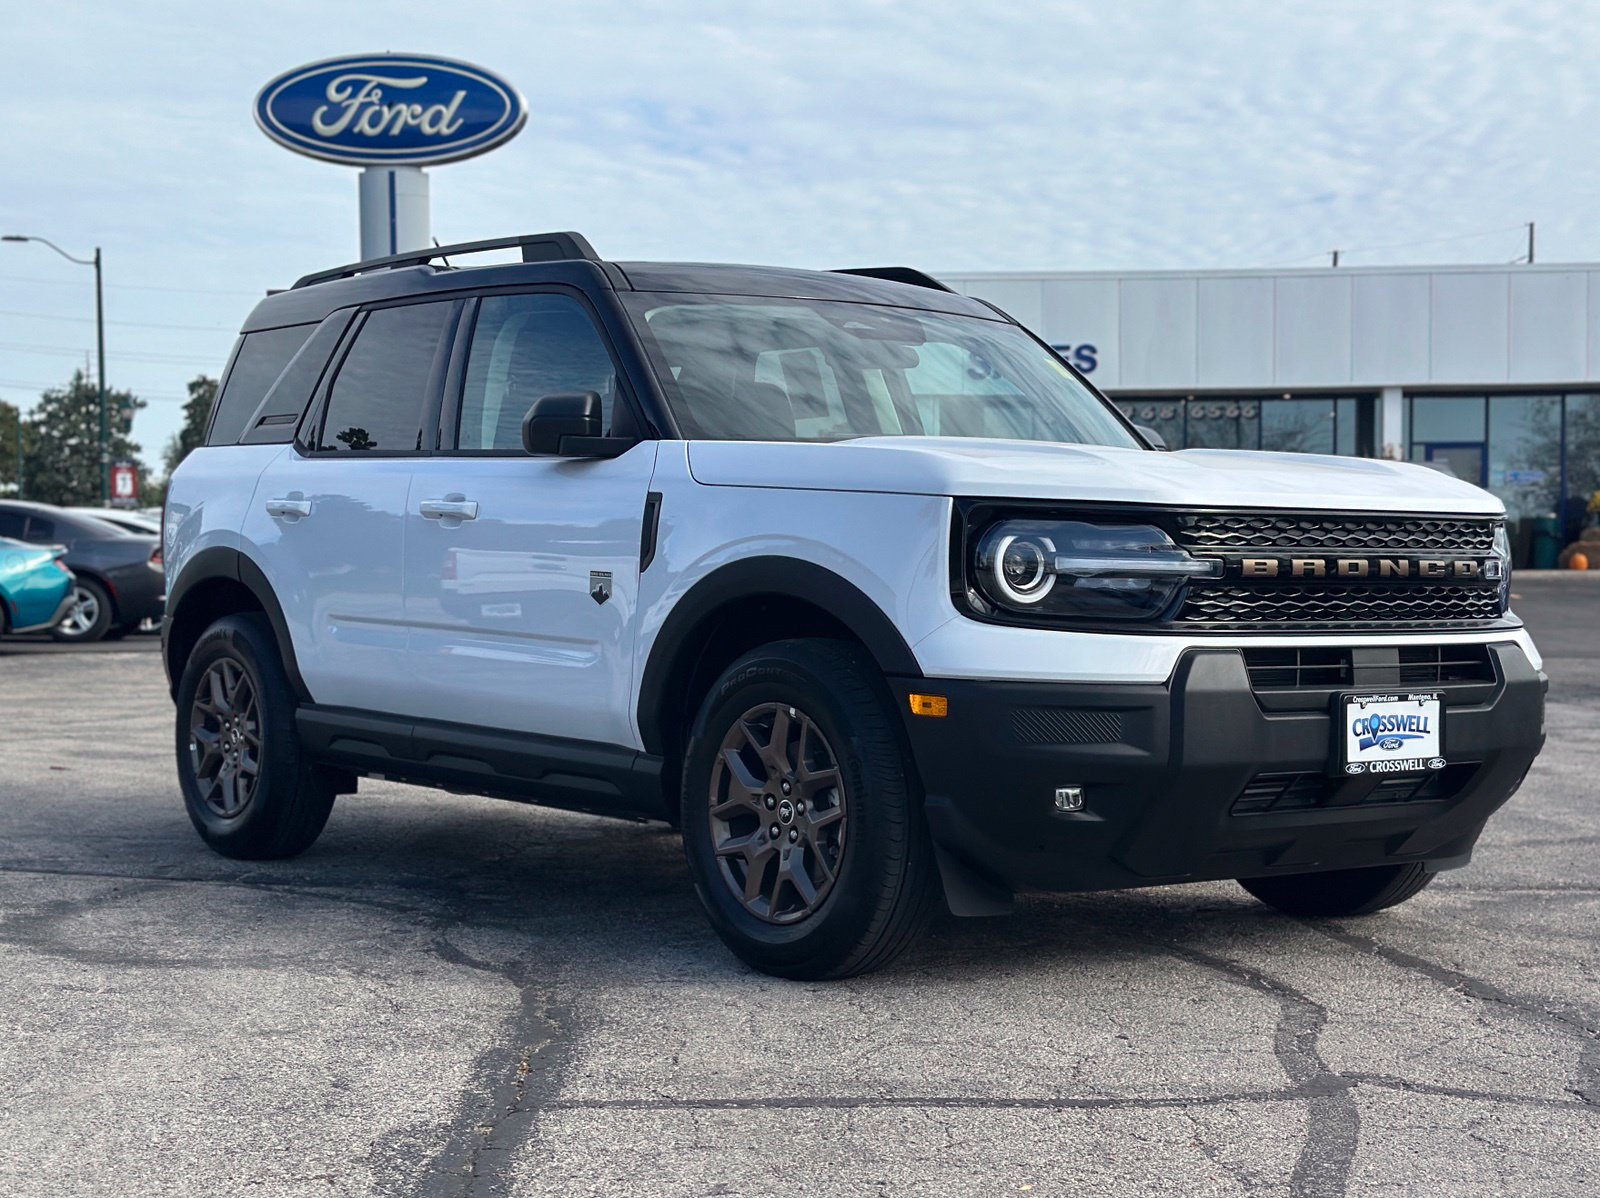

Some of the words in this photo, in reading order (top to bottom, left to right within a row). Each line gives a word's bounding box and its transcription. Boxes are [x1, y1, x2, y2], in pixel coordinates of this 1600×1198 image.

[311, 73, 468, 137] Ford
[1240, 558, 1480, 579] BRONCO
[1352, 713, 1431, 738] CROSSWELL
[1369, 758, 1425, 774] CROSSWELL
